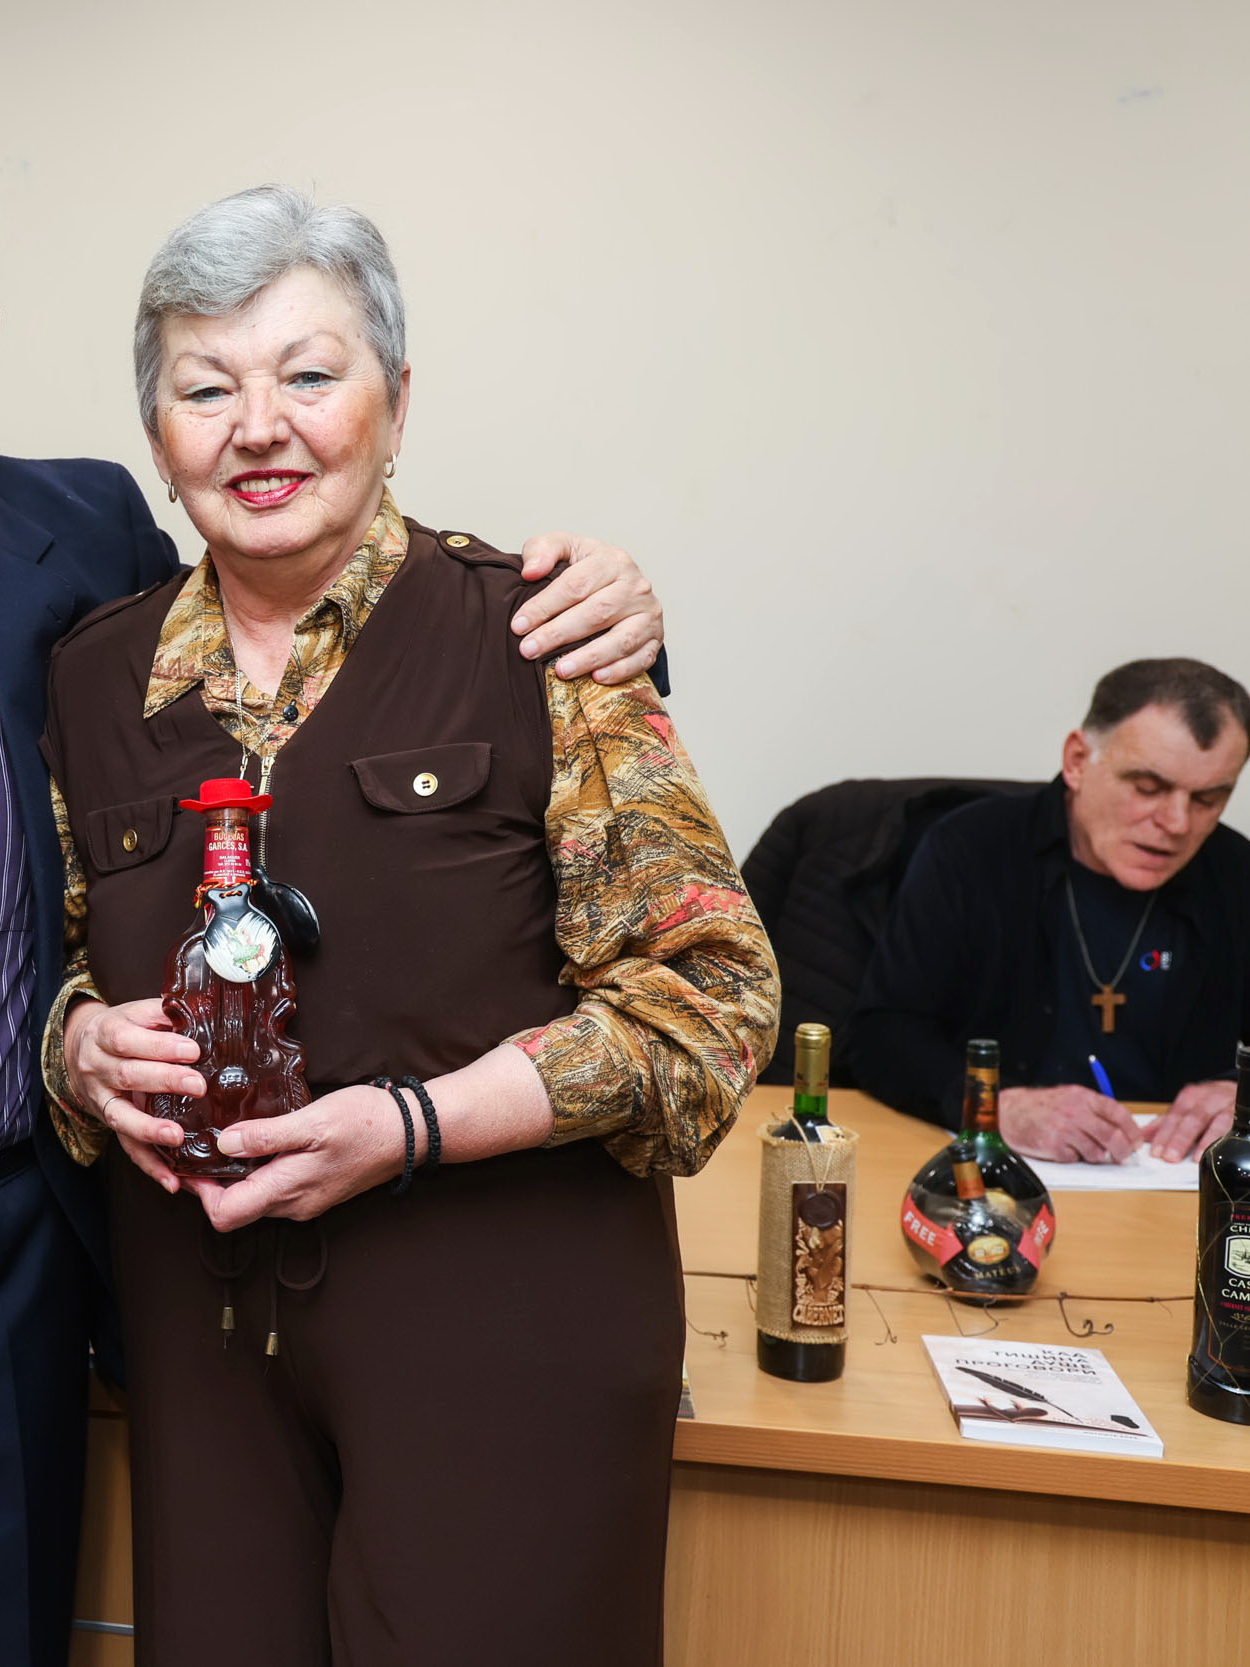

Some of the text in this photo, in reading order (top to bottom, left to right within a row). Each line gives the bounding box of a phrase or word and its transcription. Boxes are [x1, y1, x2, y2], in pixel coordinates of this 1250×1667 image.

[903, 1211, 937, 1247] FREE
[974, 1265, 1023, 1281] MATEUS
[1221, 1288, 1250, 1302] CAM
[793, 1304, 844, 1326] CABERNET
